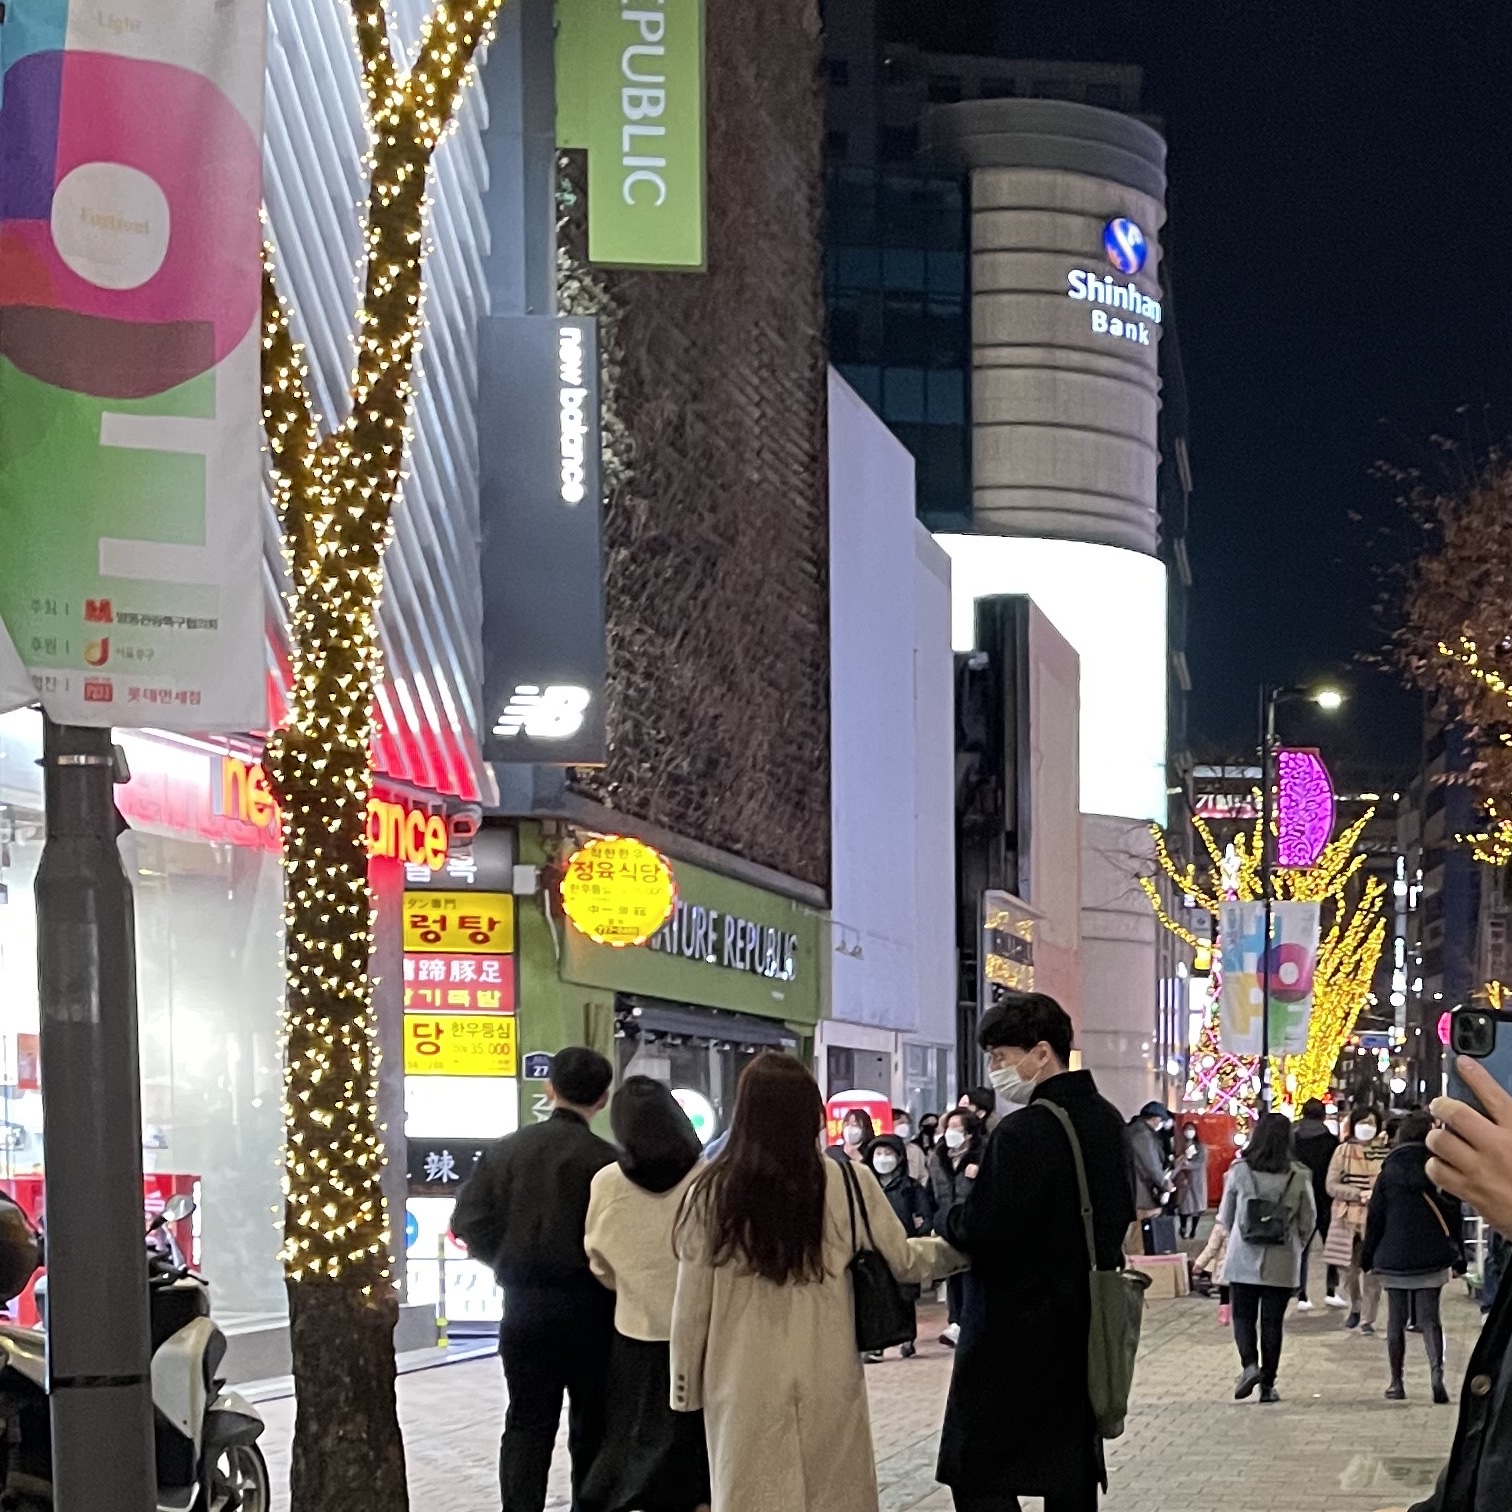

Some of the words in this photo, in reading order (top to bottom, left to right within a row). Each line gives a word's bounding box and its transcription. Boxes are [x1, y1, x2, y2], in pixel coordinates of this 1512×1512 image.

[620, 0, 667, 207] PUBLIC
[1067, 269, 1162, 324] Shinhan
[1091, 309, 1150, 346] Bank
[221, 757, 283, 828] ne
[573, 860, 661, 883] 정육식당
[723, 913, 798, 983] REPUBLIC
[412, 1021, 445, 1056] 당
